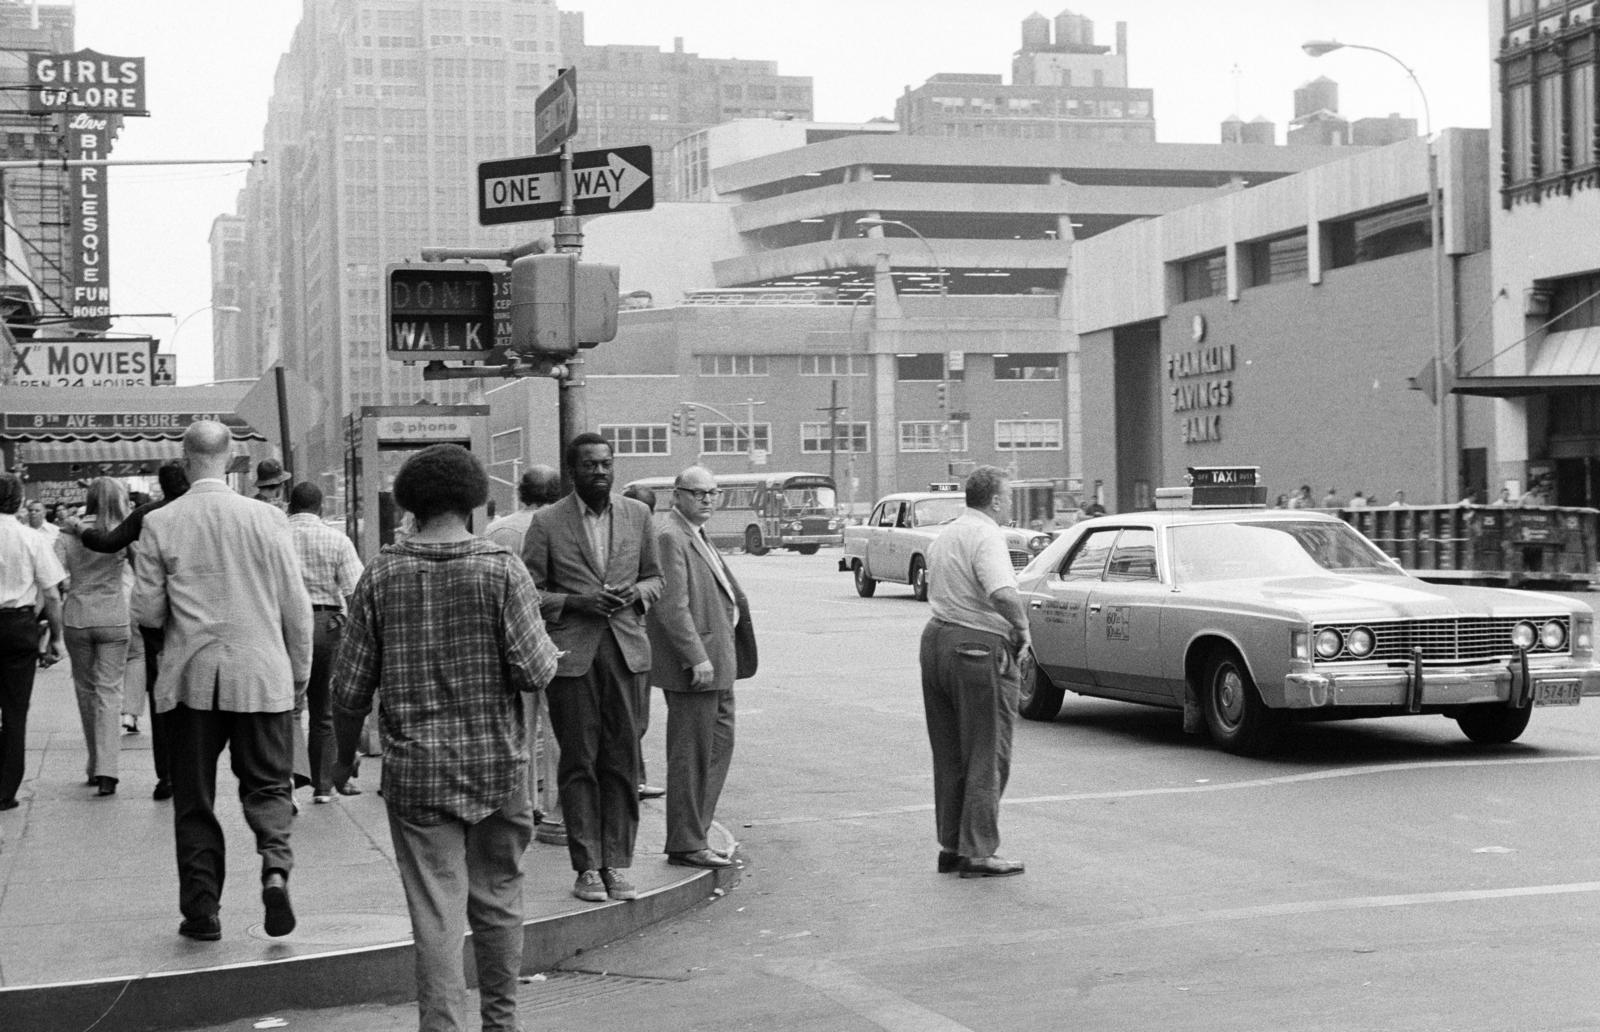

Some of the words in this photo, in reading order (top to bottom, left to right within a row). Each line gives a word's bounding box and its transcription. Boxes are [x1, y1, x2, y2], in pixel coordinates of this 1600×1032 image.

[37, 59, 138, 84] GIRLS
[40, 88, 136, 107] GALORE
[69, 113, 107, 130] Live
[492, 176, 541, 204] ONE
[574, 168, 626, 196] WAY
[80, 134, 99, 282] BURLESQUE
[75, 287, 108, 301] FUN
[73, 306, 110, 318] HOUSE
[394, 322, 483, 350] WALK
[48, 346, 146, 375] MOVIES
[1167, 344, 1235, 378] FRANKLIN
[1170, 380, 1233, 412] SAVINGS
[113, 414, 180, 427] LEISURE
[408, 422, 458, 433] phone
[1181, 415, 1222, 444] BANK
[1212, 470, 1237, 483] TAXI
